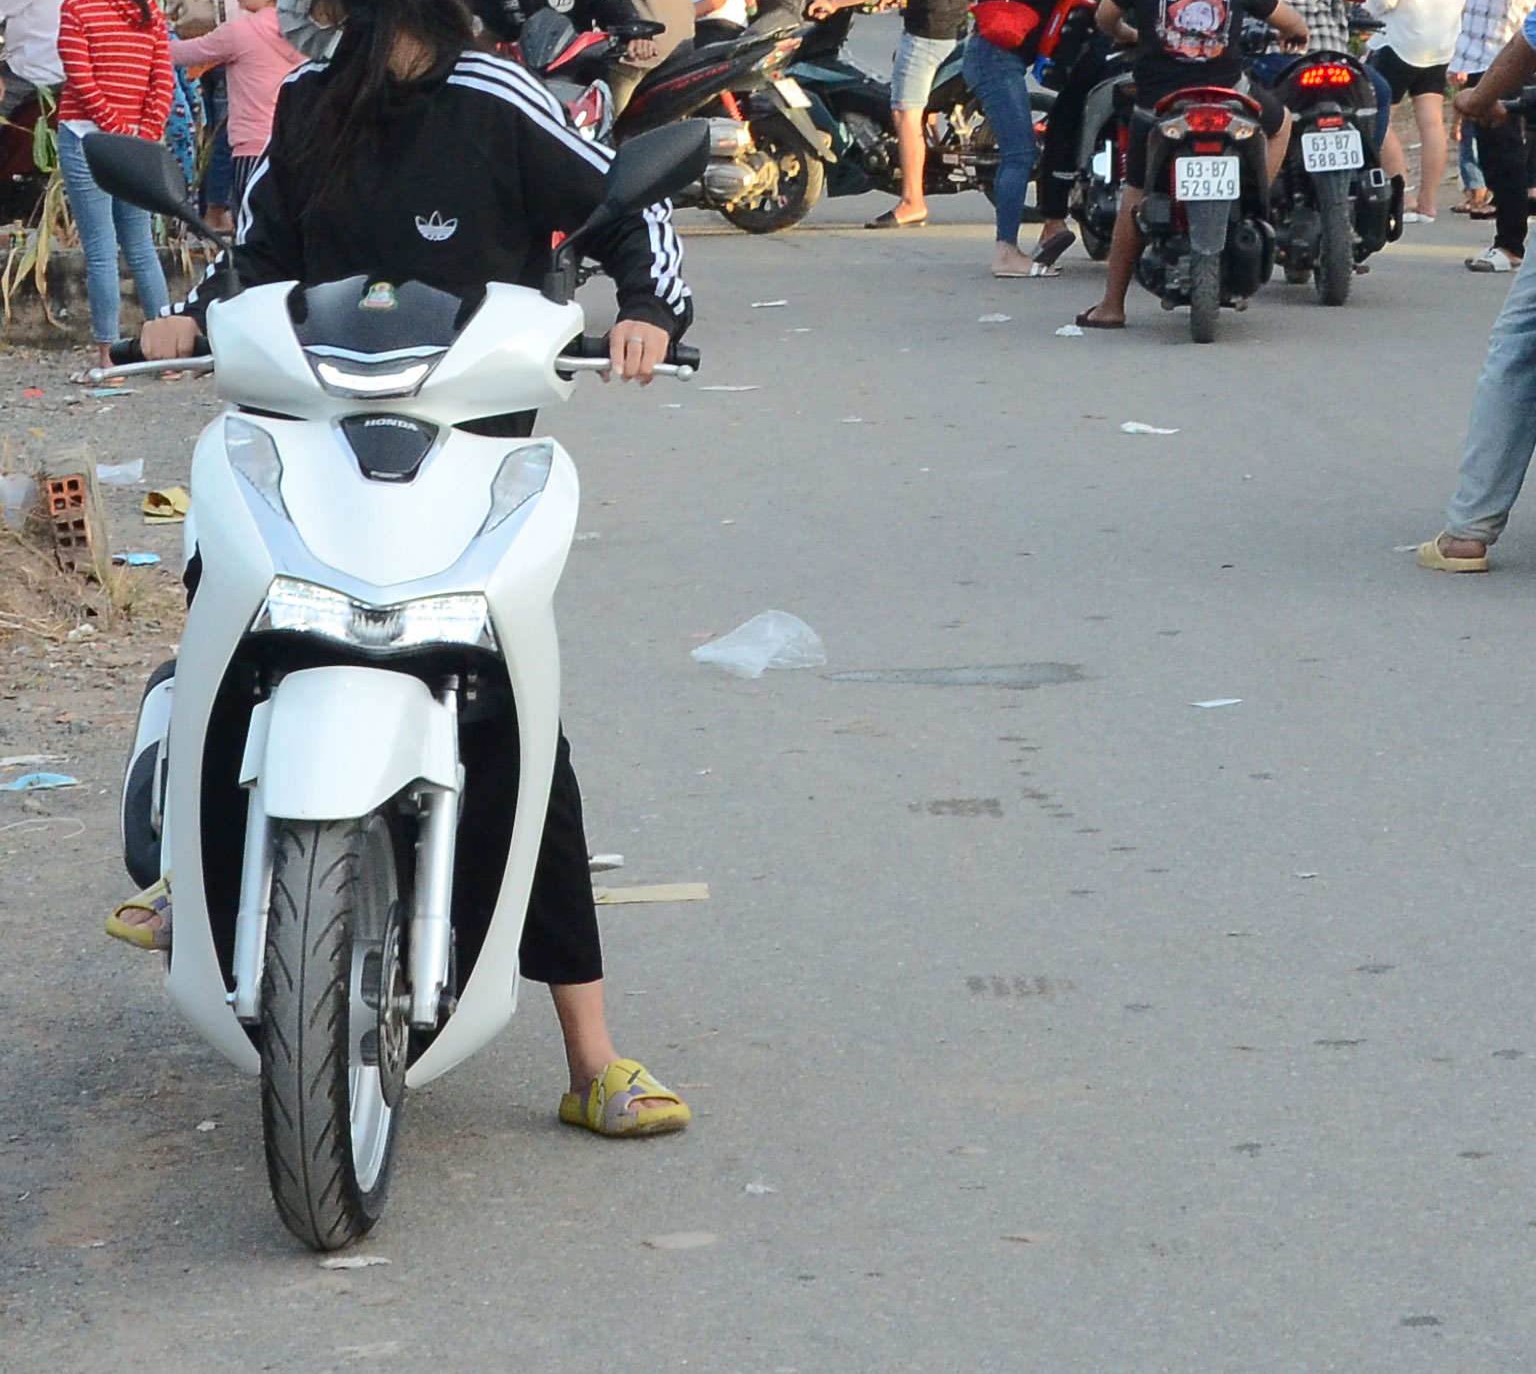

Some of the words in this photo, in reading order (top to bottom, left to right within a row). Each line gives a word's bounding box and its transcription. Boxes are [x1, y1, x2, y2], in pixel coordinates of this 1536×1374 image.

[1186, 161, 1228, 178] 63-B7
[1181, 180, 1236, 197] 529.49
[365, 418, 420, 432] HONDA
